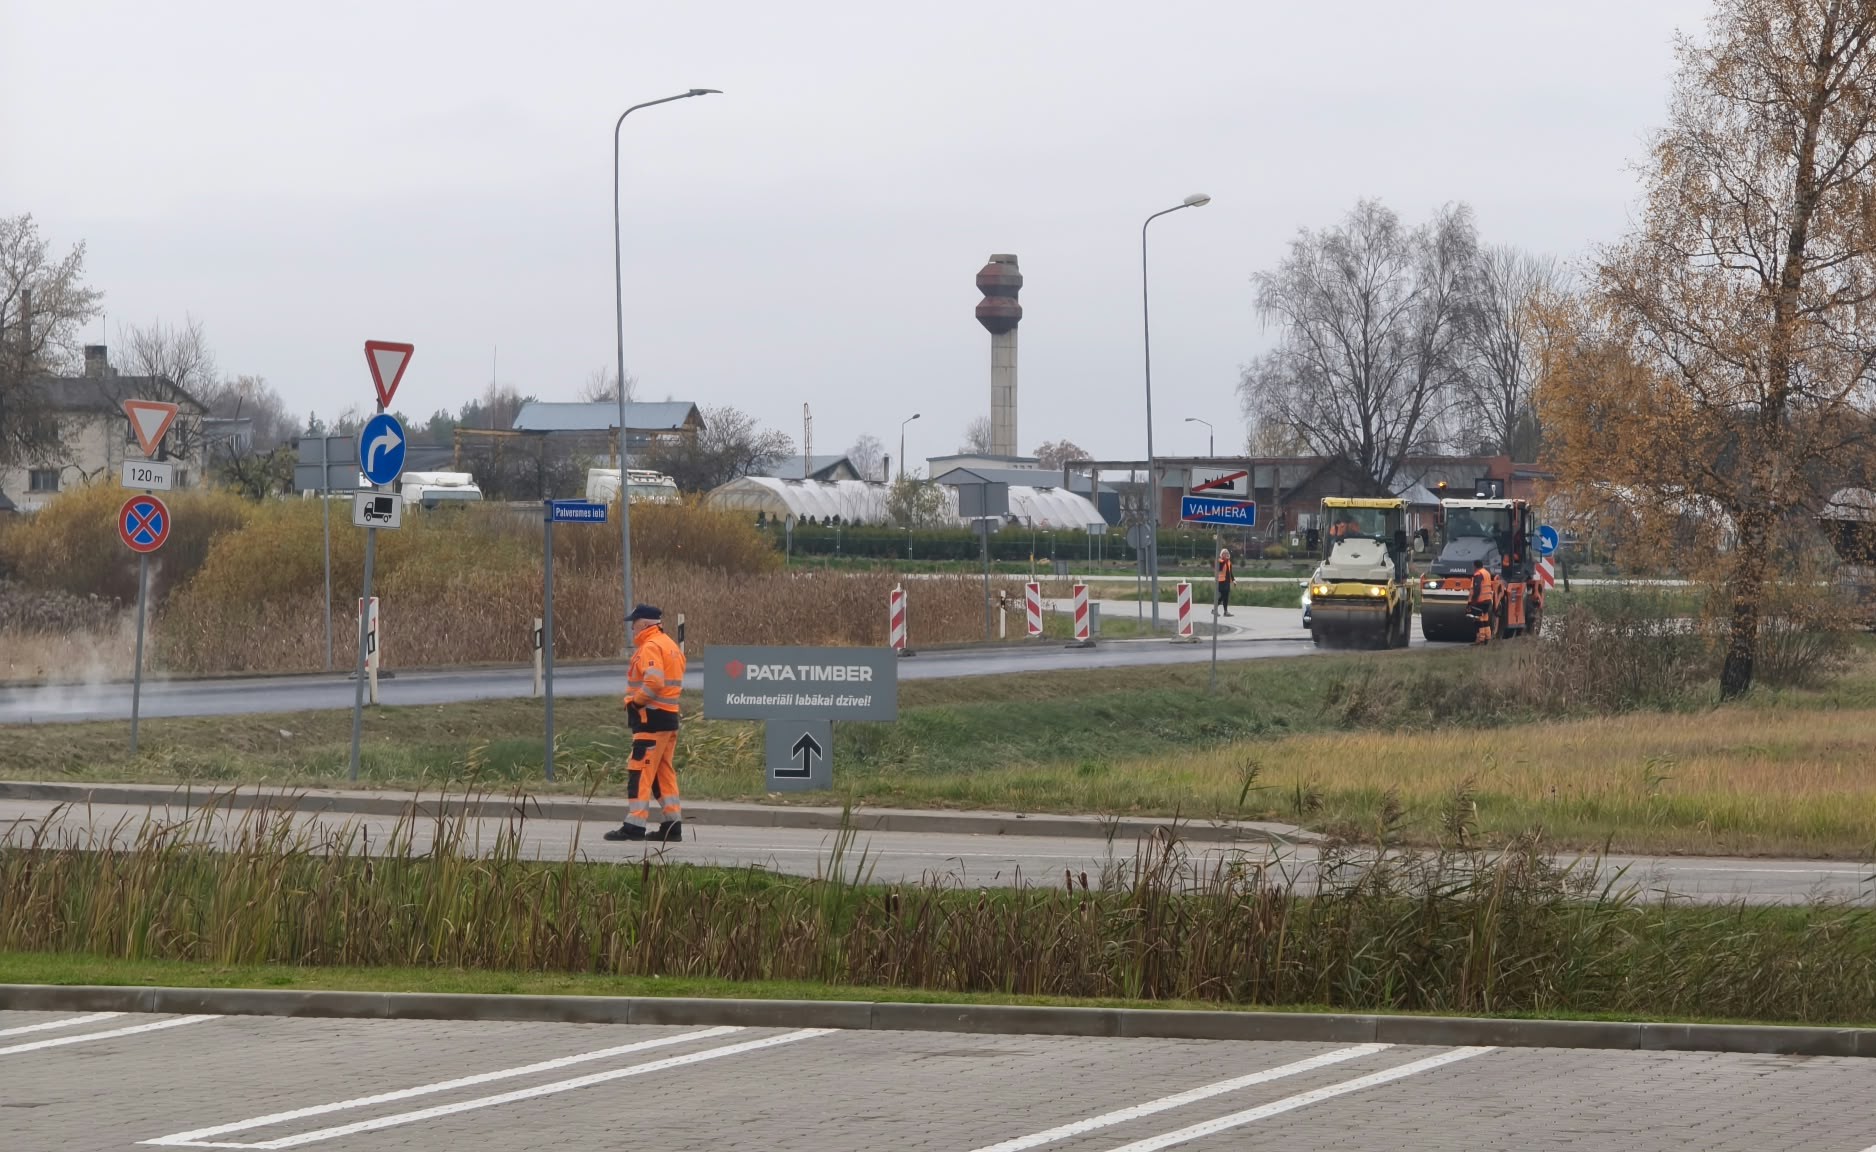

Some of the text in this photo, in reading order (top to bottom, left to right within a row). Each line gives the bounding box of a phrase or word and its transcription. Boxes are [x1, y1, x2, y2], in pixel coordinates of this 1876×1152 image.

[132, 468, 163, 483] 120 m
[592, 508, 605, 518] iela
[1189, 503, 1247, 519] VALMIERA
[746, 664, 873, 682] PATA TIMBER
[726, 693, 872, 707] Kokmateriāli labākai dzīvei!
